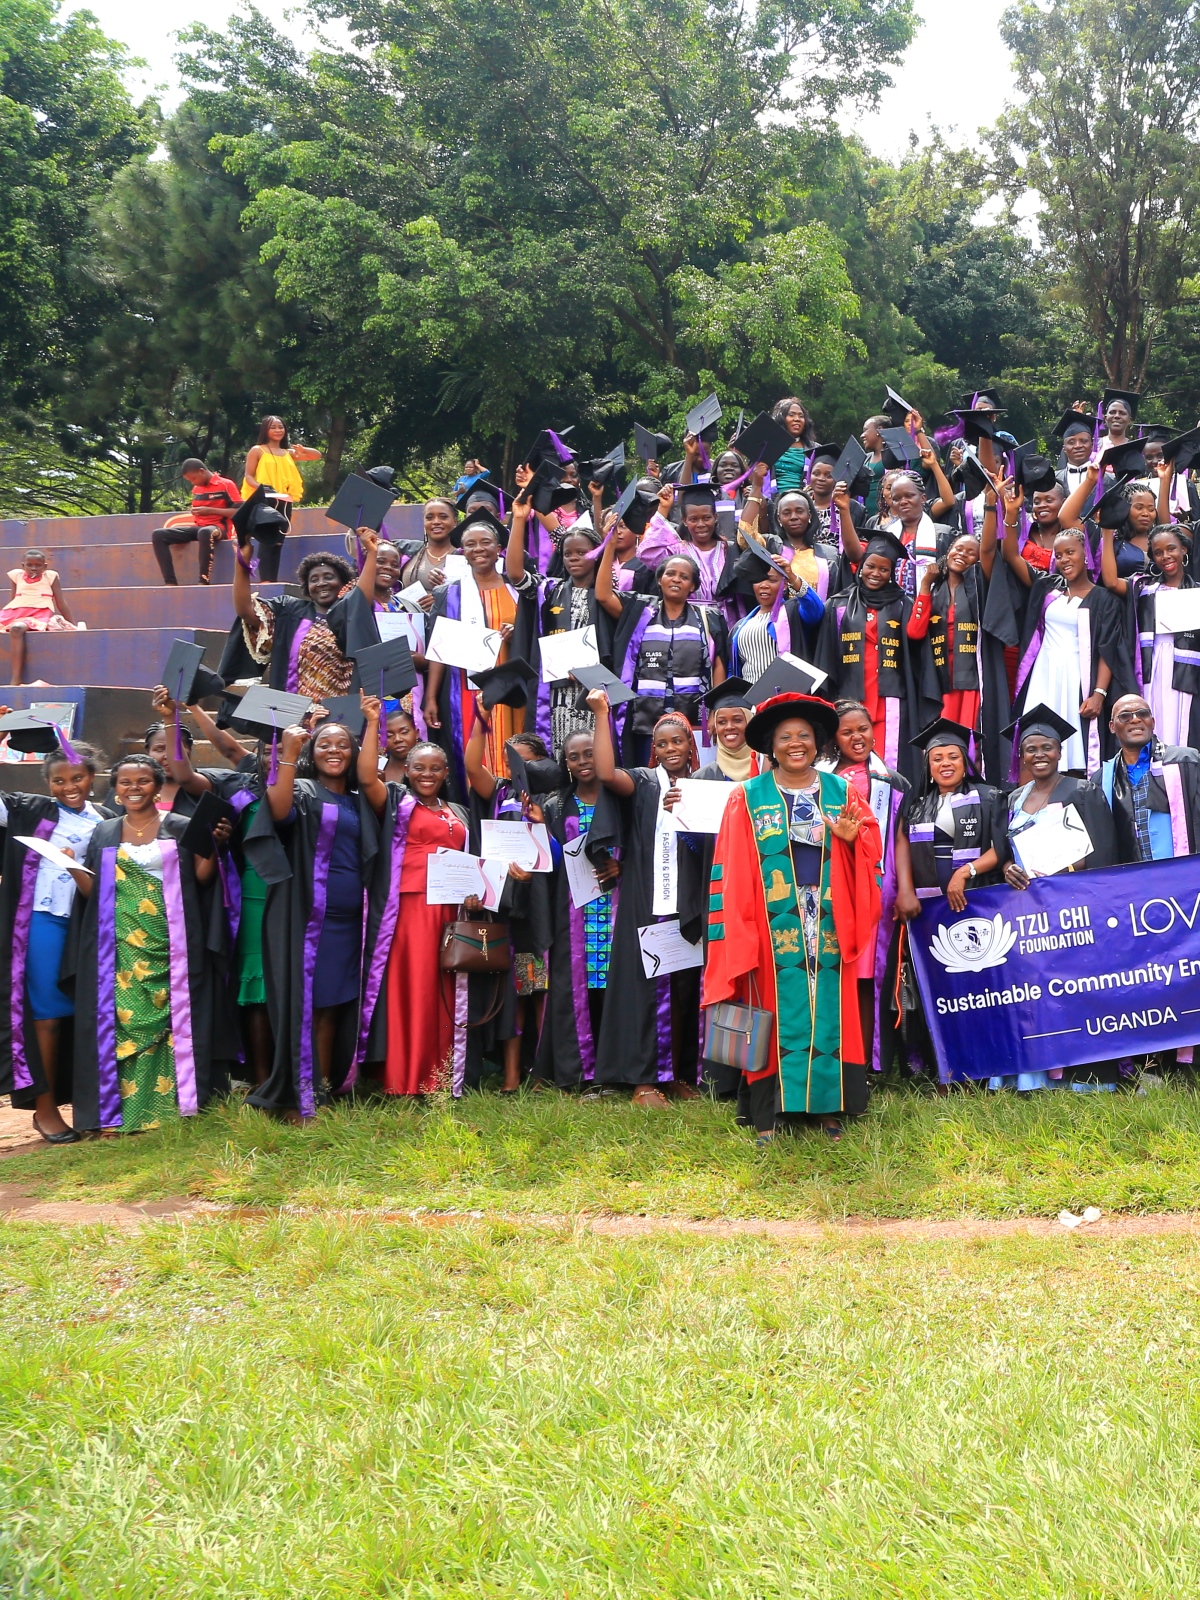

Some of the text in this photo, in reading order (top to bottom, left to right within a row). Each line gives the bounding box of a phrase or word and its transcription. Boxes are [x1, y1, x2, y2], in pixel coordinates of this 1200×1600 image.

[841, 632, 862, 642] FASHION
[881, 637, 900, 647] CLASS
[966, 633, 970, 641] &
[850, 643, 854, 652] &
[934, 647, 942, 656] OF
[886, 649, 895, 657] OF
[842, 654, 860, 663] DESIGN
[934, 657, 945, 667] 024
[882, 660, 897, 668] 2024
[1016, 905, 1090, 938] TZU CHI
[1019, 929, 1095, 955] FOUNDATION
[936, 982, 1042, 1014] Sustainable
[1048, 962, 1173, 997] Community
[1086, 1006, 1178, 1036] UGANDA
